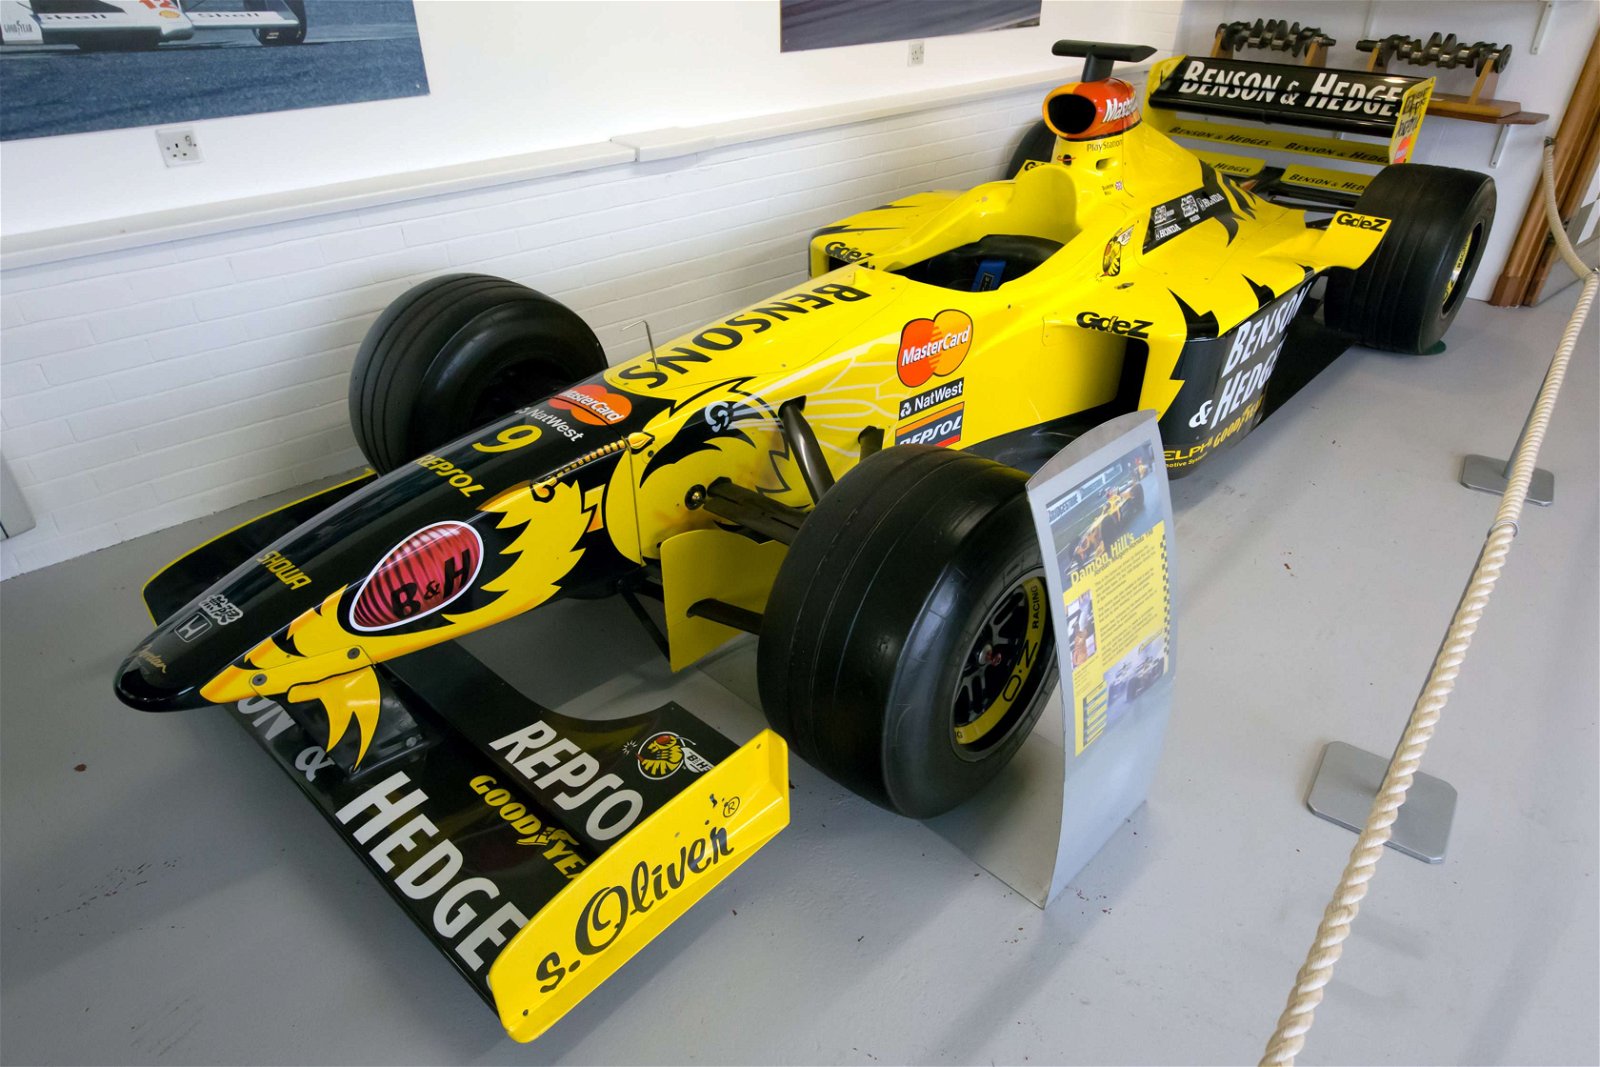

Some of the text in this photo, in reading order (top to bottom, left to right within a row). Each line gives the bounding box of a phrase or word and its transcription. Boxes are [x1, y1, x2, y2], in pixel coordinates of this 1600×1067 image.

[1178, 60, 1282, 103] BENSON
[1279, 80, 1300, 106] &
[1304, 72, 1403, 117] HEDGE
[1169, 126, 1215, 140] BENSON
[1225, 133, 1272, 147] HEDGES
[1284, 141, 1336, 156] BENSON
[1215, 162, 1252, 174] HEDGES
[1288, 173, 1329, 187] BENSON
[1341, 181, 1365, 191] HED
[618, 283, 873, 389] BENSONS
[901, 324, 972, 368] MasterCard
[1221, 282, 1313, 378] BENSON
[913, 380, 963, 412] NatWest
[1188, 399, 1214, 429] &
[471, 424, 543, 453] 9
[527, 407, 585, 442] NatWest
[1163, 436, 1215, 461] ELPHI
[415, 454, 486, 498] REPSOL
[255, 550, 313, 591] SHOWA
[1070, 552, 1109, 585] Damon
[1110, 532, 1135, 560] Hill's
[1031, 584, 1040, 630] RACING
[487, 719, 644, 842] REPSO
[468, 774, 589, 880] GOODYE
[334, 770, 530, 973] HEDGE
[535, 821, 735, 994] s.Oliver
